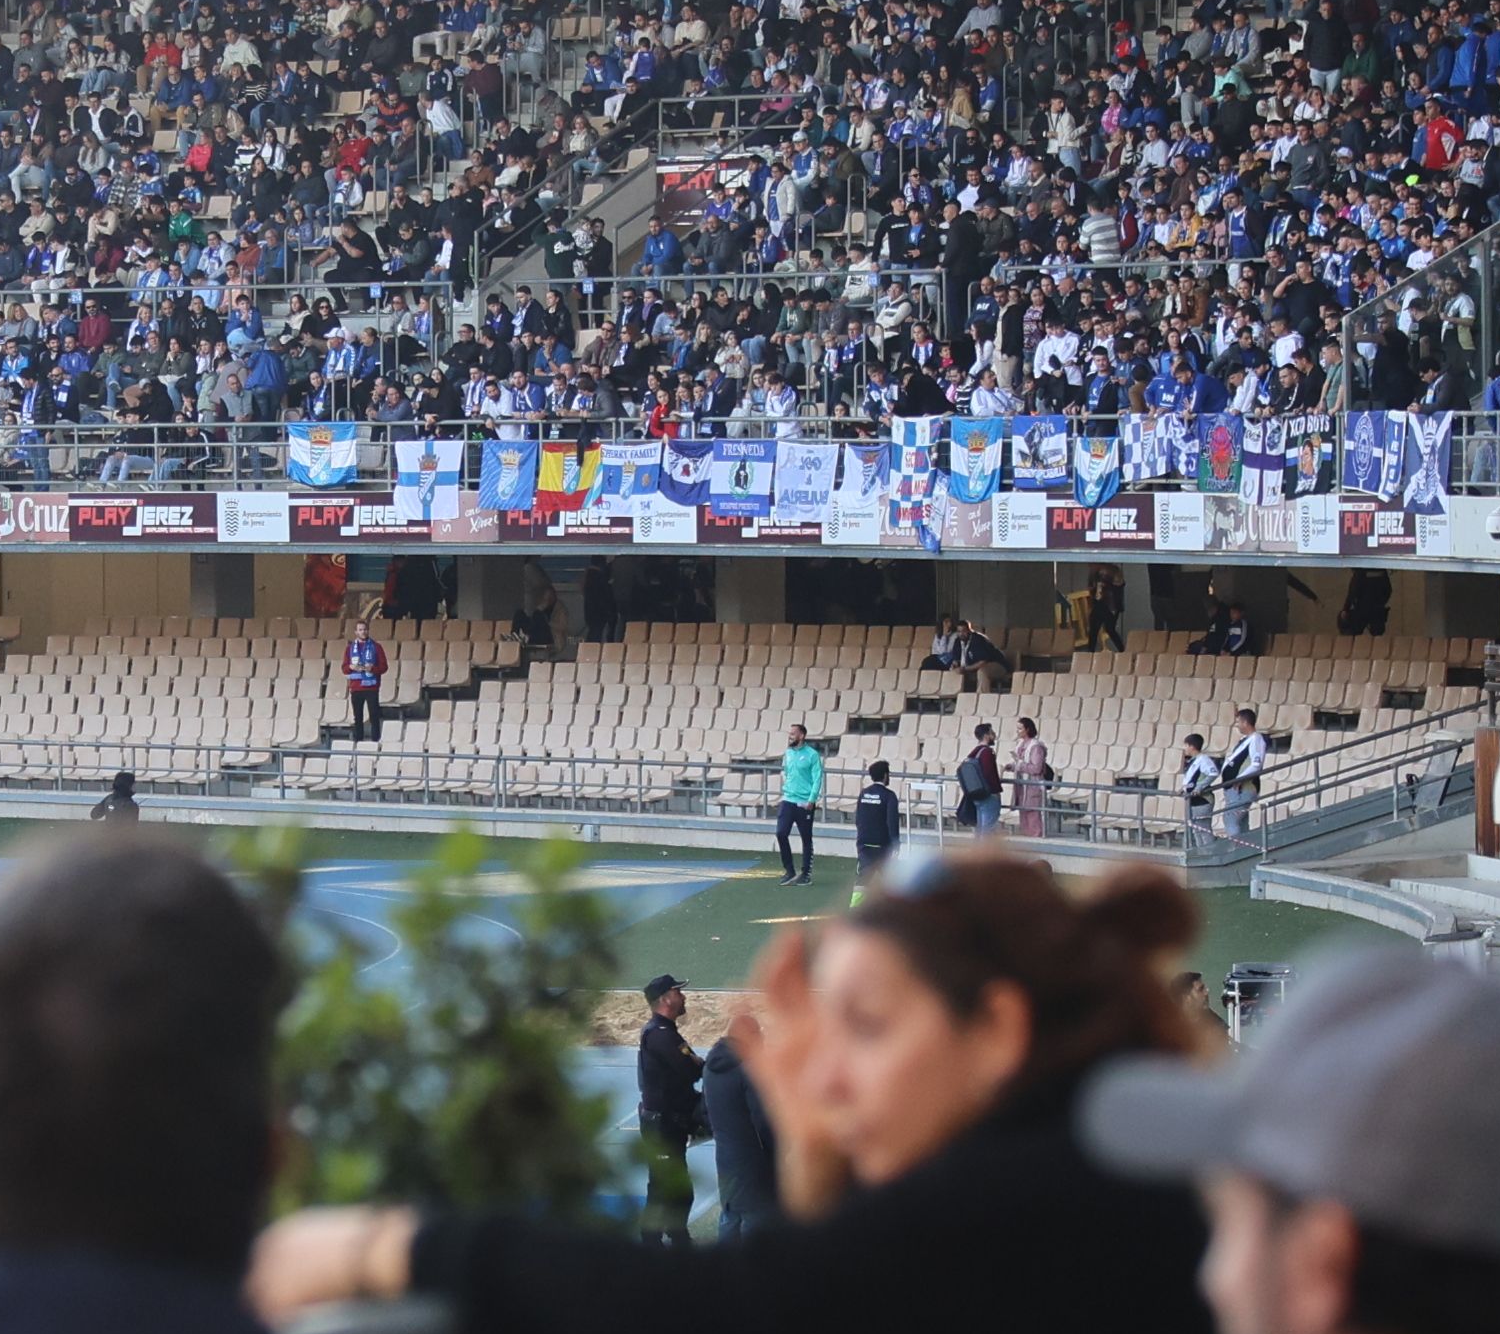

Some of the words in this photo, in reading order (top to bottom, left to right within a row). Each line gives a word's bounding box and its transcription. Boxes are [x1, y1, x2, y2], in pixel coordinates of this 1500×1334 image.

[1306, 415, 1331, 433] BOYS
[78, 507, 131, 525] PLAY
[122, 506, 194, 536] JEREZ
[241, 511, 282, 520] Ayuntamiento
[241, 519, 250, 527] de
[250, 519, 265, 529] Jerez
[297, 507, 349, 525] PLAY
[1052, 509, 1093, 529] PLAY
[1085, 508, 1138, 542] JEREZ
[1344, 511, 1372, 535] PLAY
[1367, 511, 1404, 547] JEREZ
